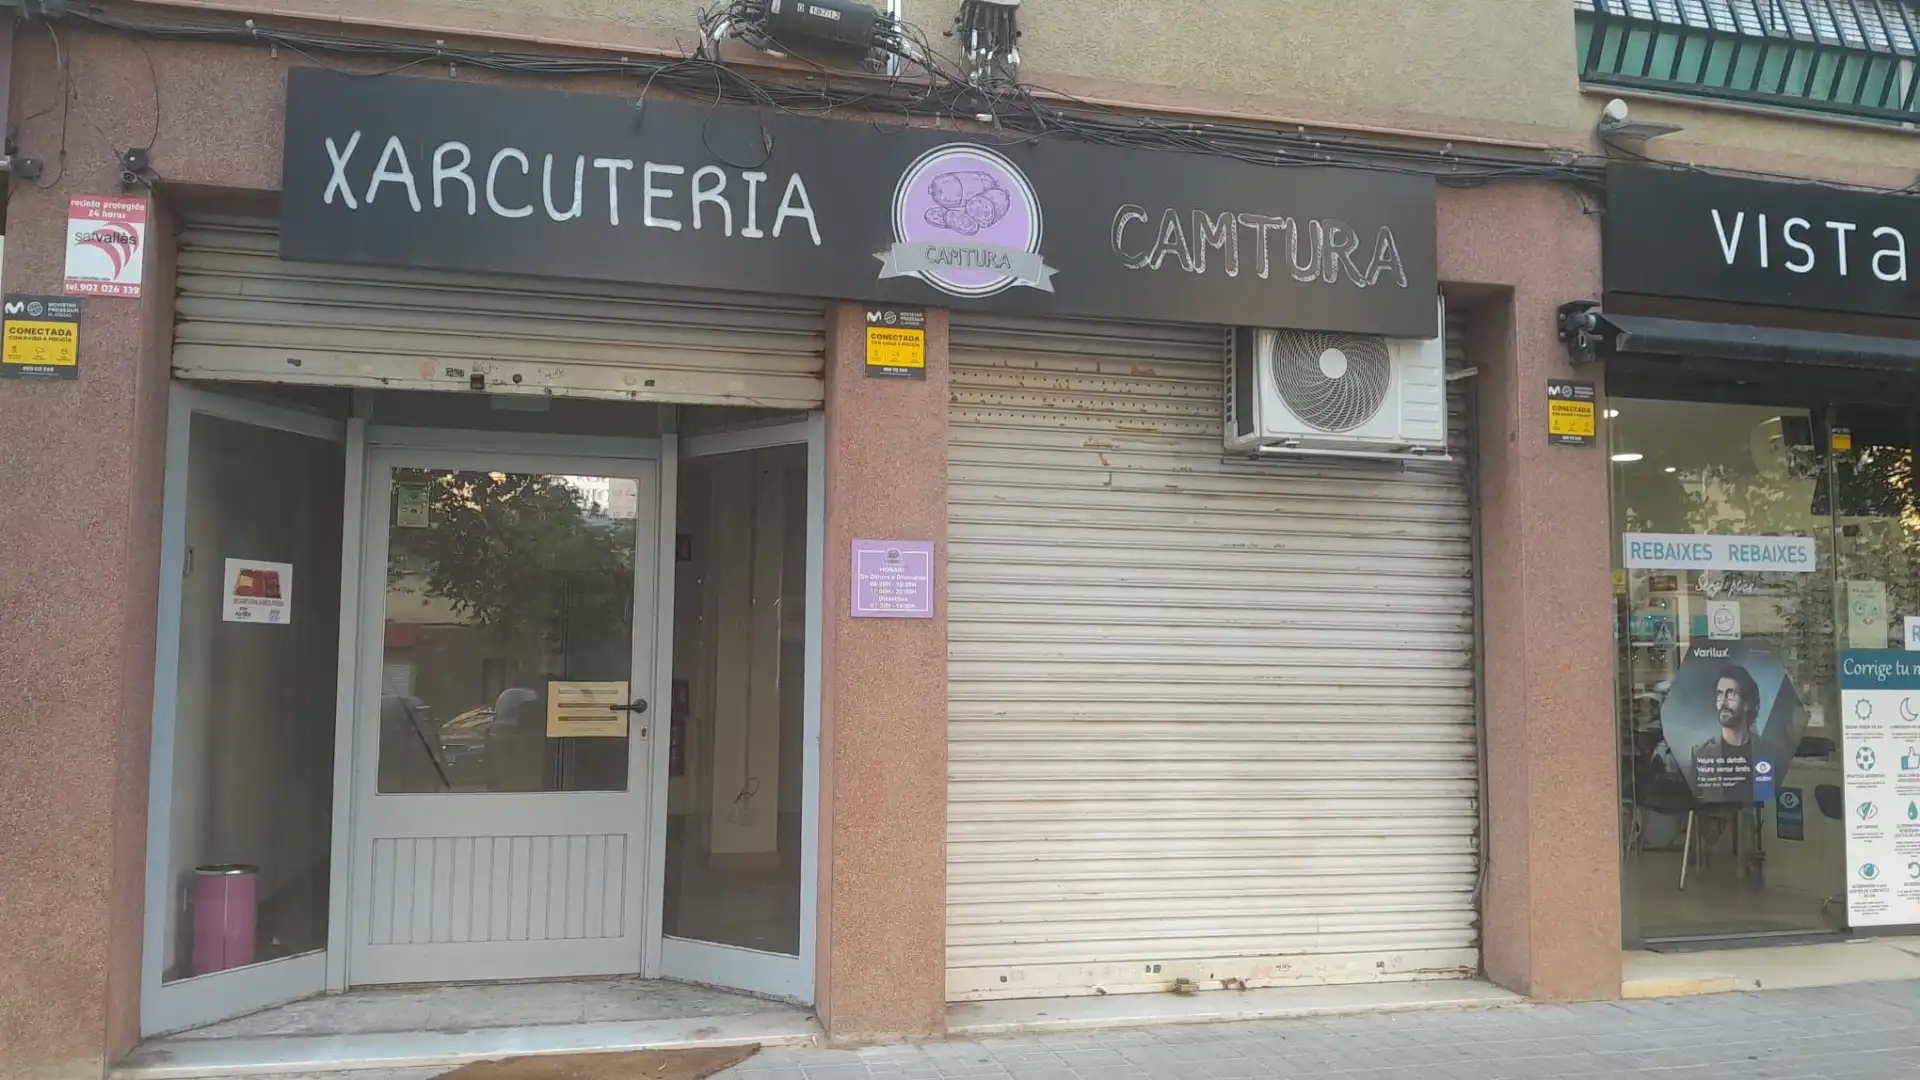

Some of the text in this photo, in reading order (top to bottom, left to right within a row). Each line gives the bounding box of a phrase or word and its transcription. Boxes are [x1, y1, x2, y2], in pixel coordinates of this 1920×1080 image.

[323, 129, 822, 246] XARCUTERIA
[71, 199, 144, 212] recinto protegido
[102, 211, 126, 219] horas
[1110, 203, 1408, 288] CAMTURA
[925, 245, 1011, 270] CAMTURA
[9, 326, 72, 337] CONECTADA
[871, 333, 920, 342] CONECTADA
[1631, 542, 1808, 563] REBAIXES REBAIXES
[1843, 658, 1893, 682] Corrige
[1896, 660, 1910, 676] tu
